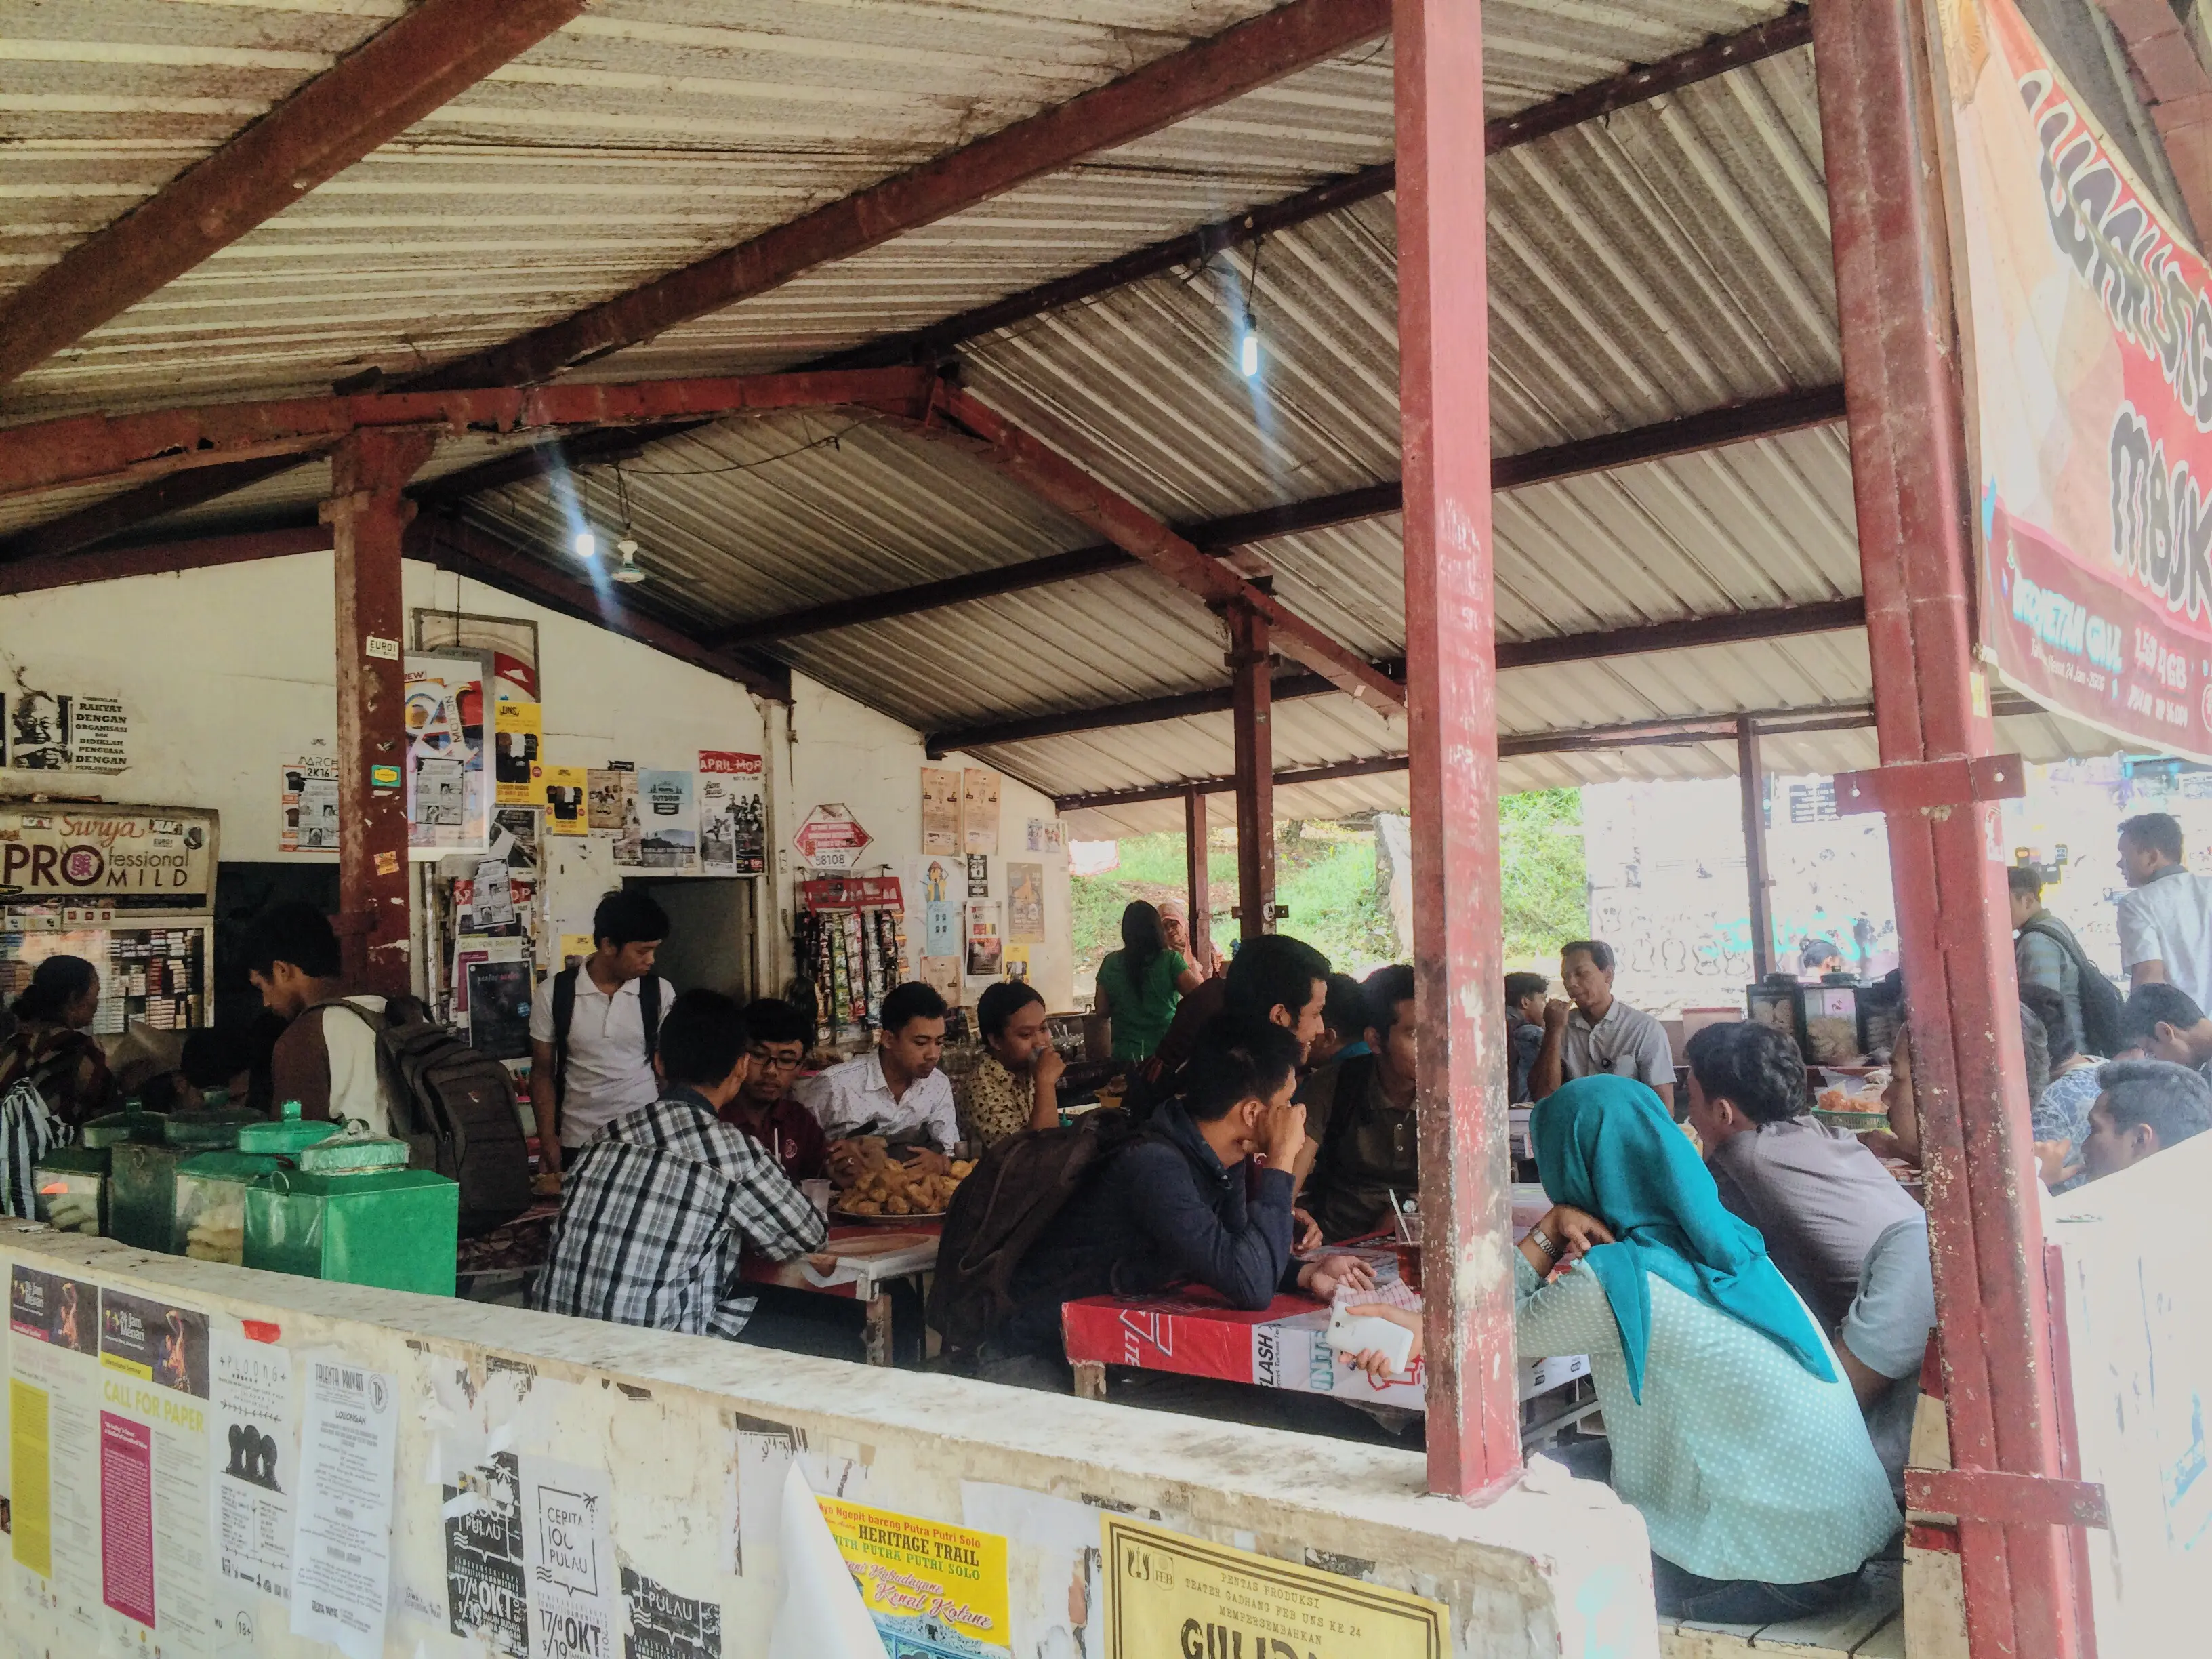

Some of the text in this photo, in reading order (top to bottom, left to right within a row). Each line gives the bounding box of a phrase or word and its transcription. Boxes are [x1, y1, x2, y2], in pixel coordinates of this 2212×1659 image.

[76, 714, 127, 724] DENGAN
[79, 703, 123, 712] RAKYAT
[76, 724, 127, 733] ORGANISASI
[76, 756, 127, 765] DENGAN
[307, 767, 330, 777] 2K16
[699, 758, 733, 771] APRIL
[60, 815, 145, 848] Surya
[106, 869, 188, 887] MILD
[104, 1380, 132, 1408] CALL
[136, 1390, 160, 1418] FOR
[335, 1410, 367, 1425] LOWONGAN
[819, 1502, 981, 1549] Ayo Ngepit bareng Putra Putri Solo
[550, 1549, 588, 1574] PULAU
[859, 1524, 980, 1567] HERITAGE TRAIL
[863, 1542, 902, 1562] PUTRA
[906, 1553, 944, 1572] PUTRI
[948, 1563, 981, 1580] SOLO
[869, 1563, 945, 1595] Kabudayane
[1221, 1572, 1320, 1610] PENTAS PRODUKSI
[478, 1580, 513, 1620] OKT
[649, 1591, 693, 1621] PULAU
[874, 1581, 994, 1629] Kenal Kotane
[1185, 1578, 1362, 1639] TEATER GADHANG FEB UNS KE 24
[565, 1617, 602, 1658] OKT
[1219, 1604, 1322, 1646] MEMPERSEMBAHKAN
